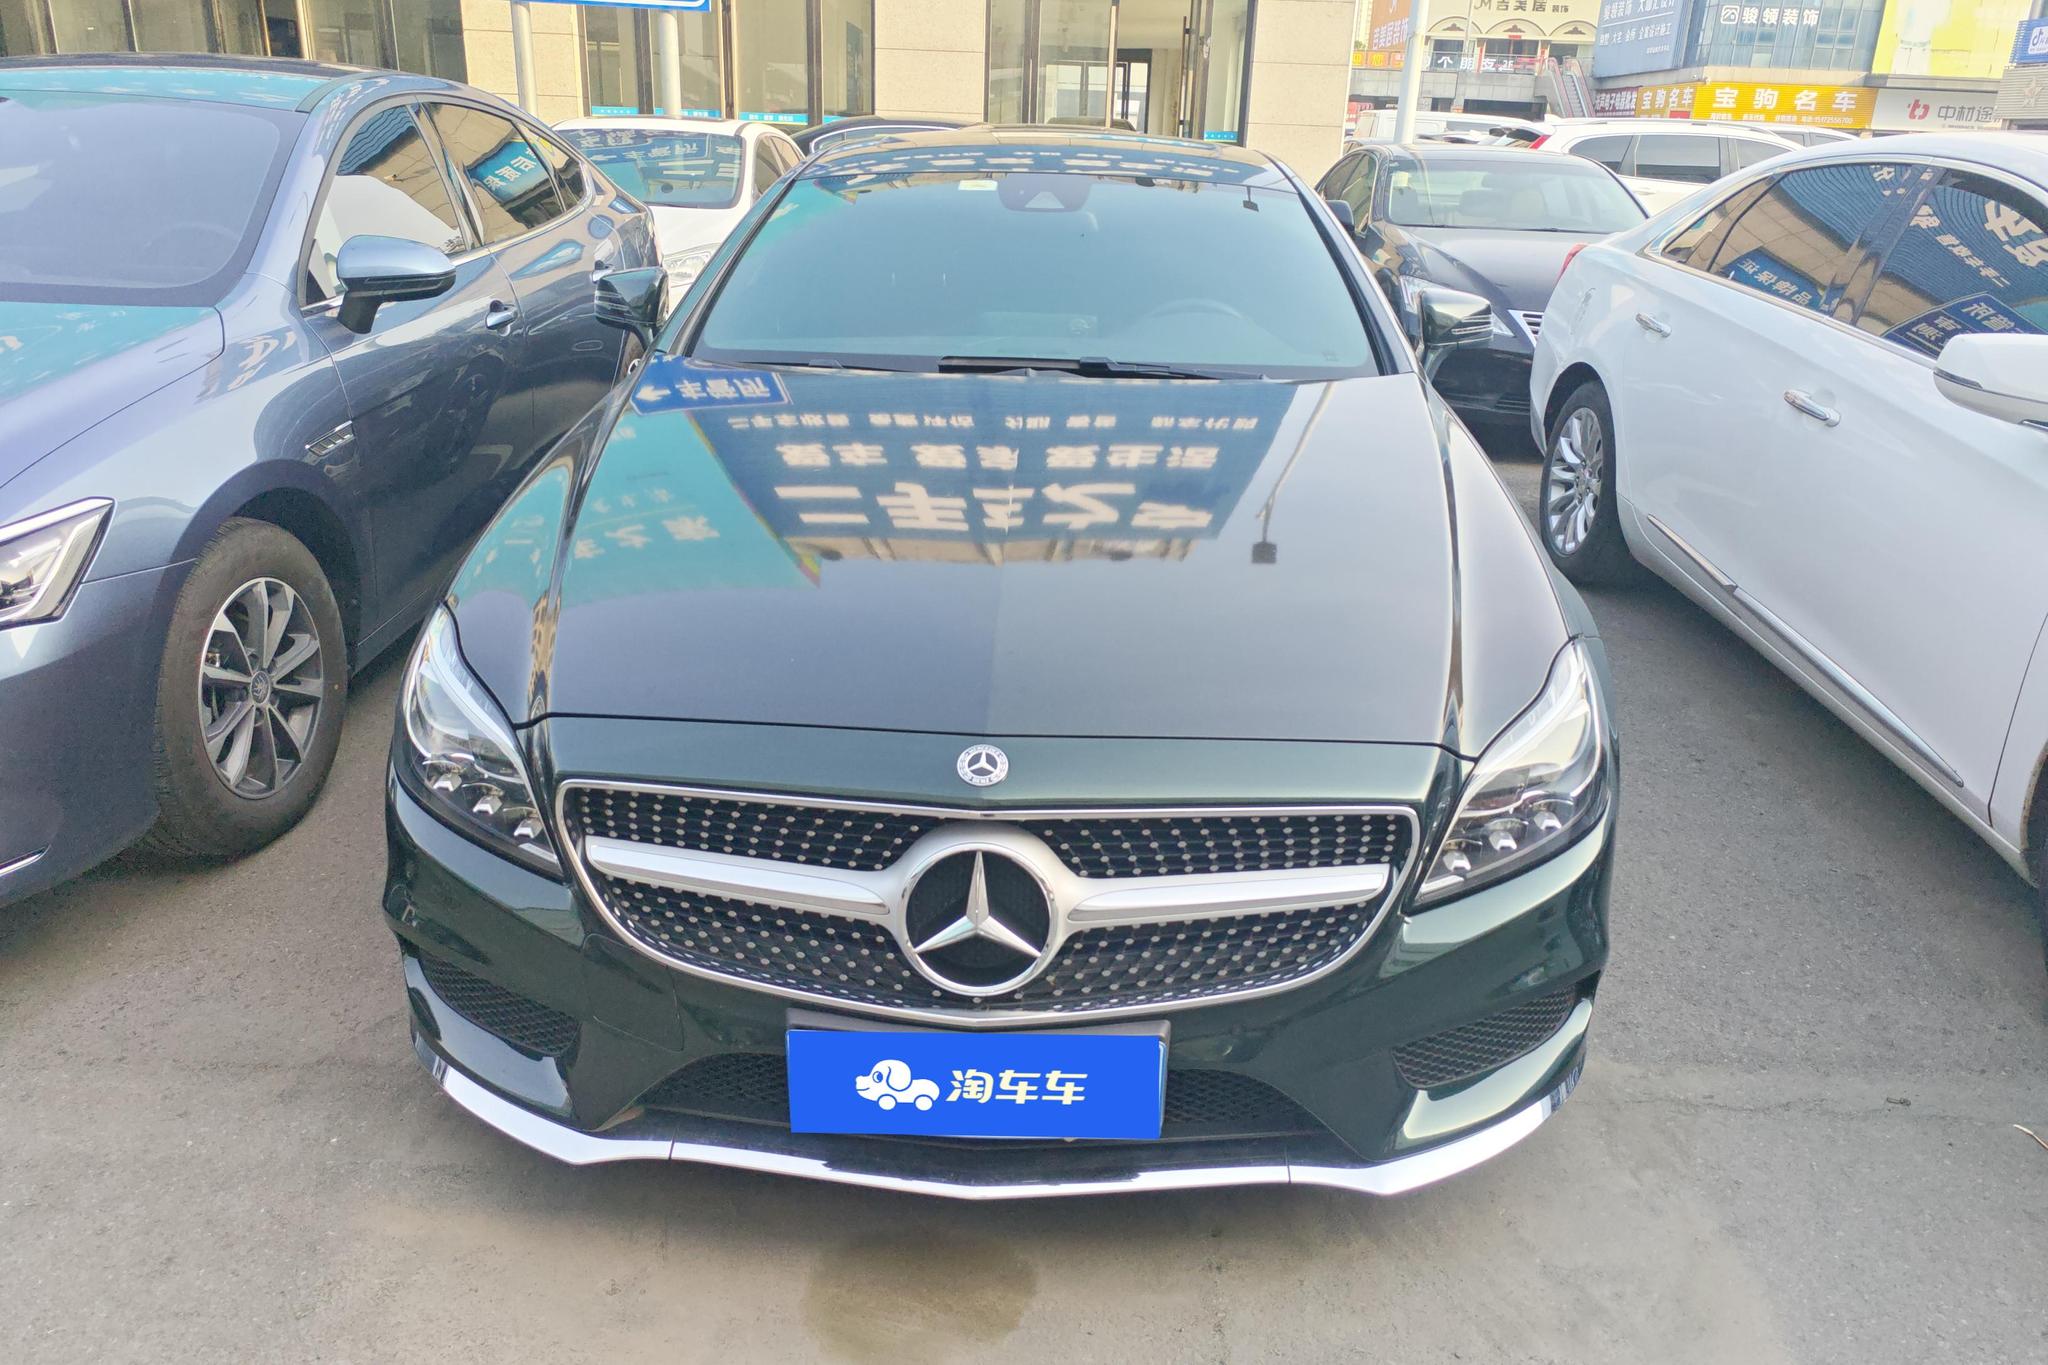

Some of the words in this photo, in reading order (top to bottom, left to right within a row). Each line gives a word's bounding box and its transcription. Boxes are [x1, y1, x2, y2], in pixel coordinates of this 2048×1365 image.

[1742, 7, 1819, 27] 骏领装饰
[1712, 87, 1857, 112] 宝驹名车
[1937, 105, 1998, 123] 中材途
